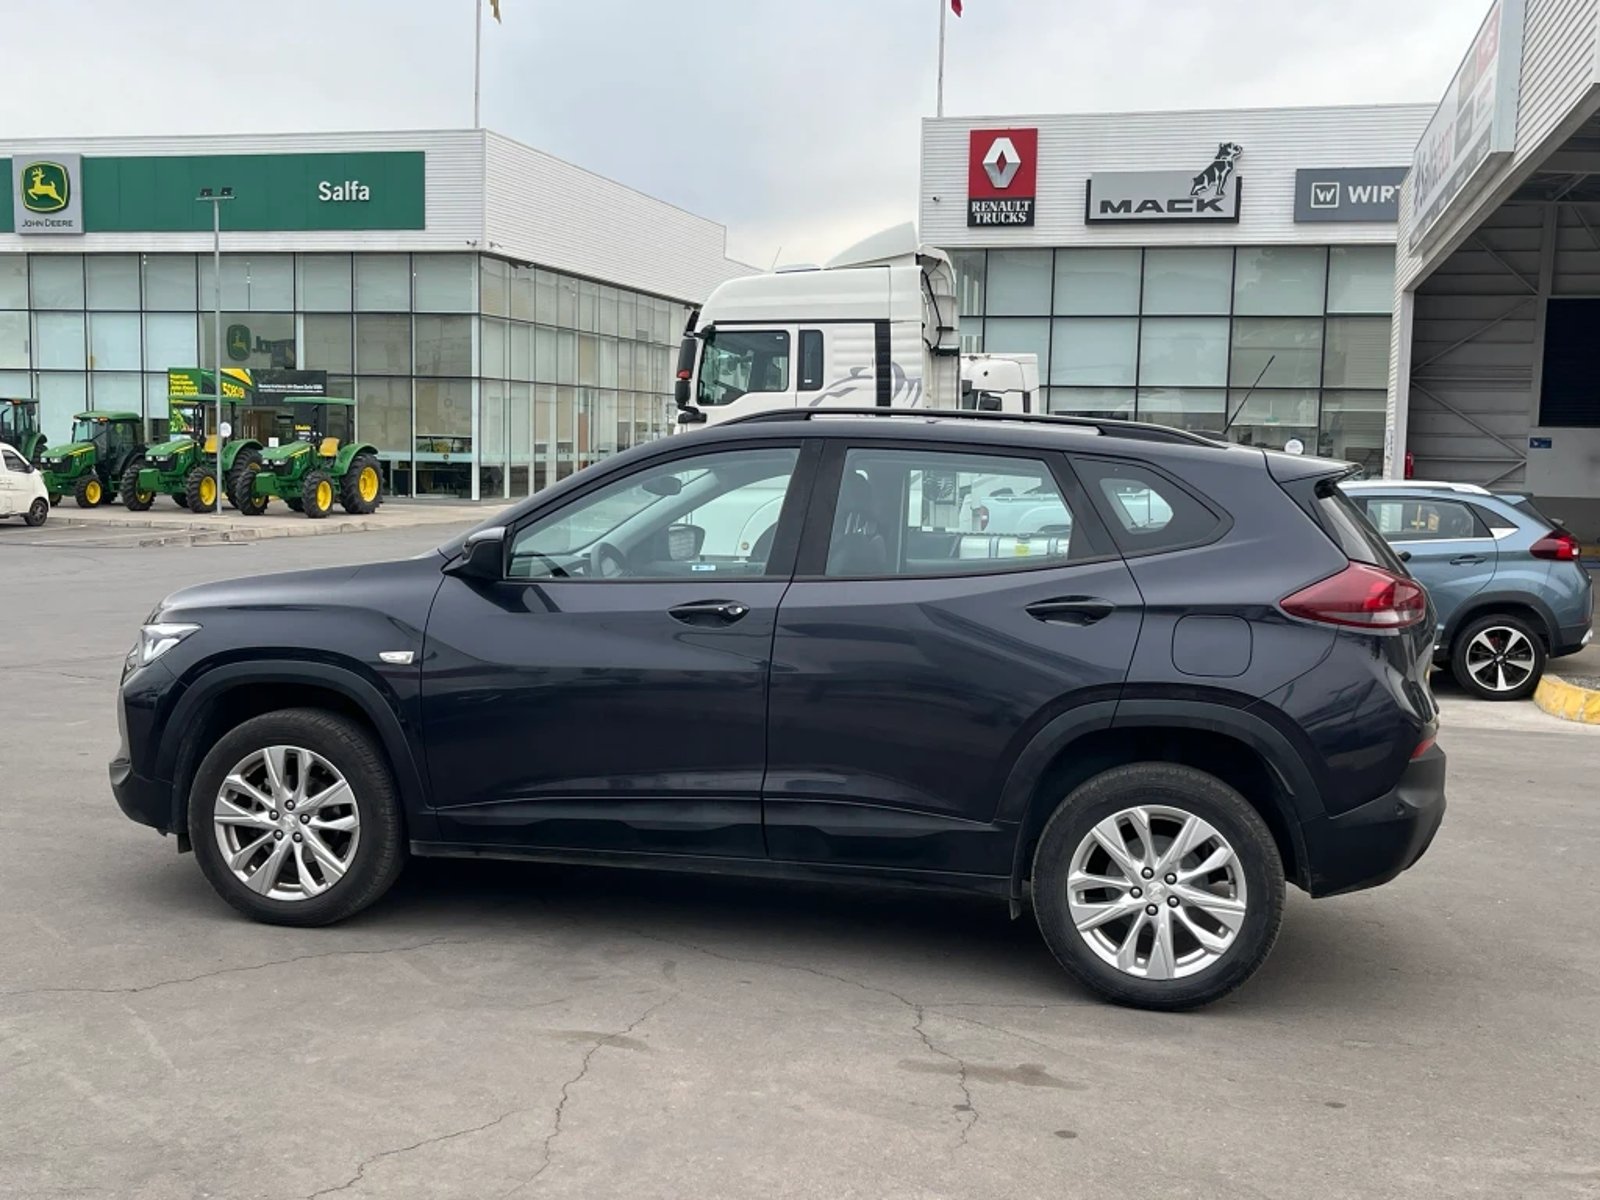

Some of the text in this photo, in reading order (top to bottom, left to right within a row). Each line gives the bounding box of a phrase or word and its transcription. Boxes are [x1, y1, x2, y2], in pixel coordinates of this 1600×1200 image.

[319, 181, 370, 201] Salfa
[971, 201, 1032, 212] RENAULT
[1100, 199, 1224, 213] MACK
[22, 218, 74, 227] JOHN DEERE
[973, 212, 1027, 224] TRUCKS
